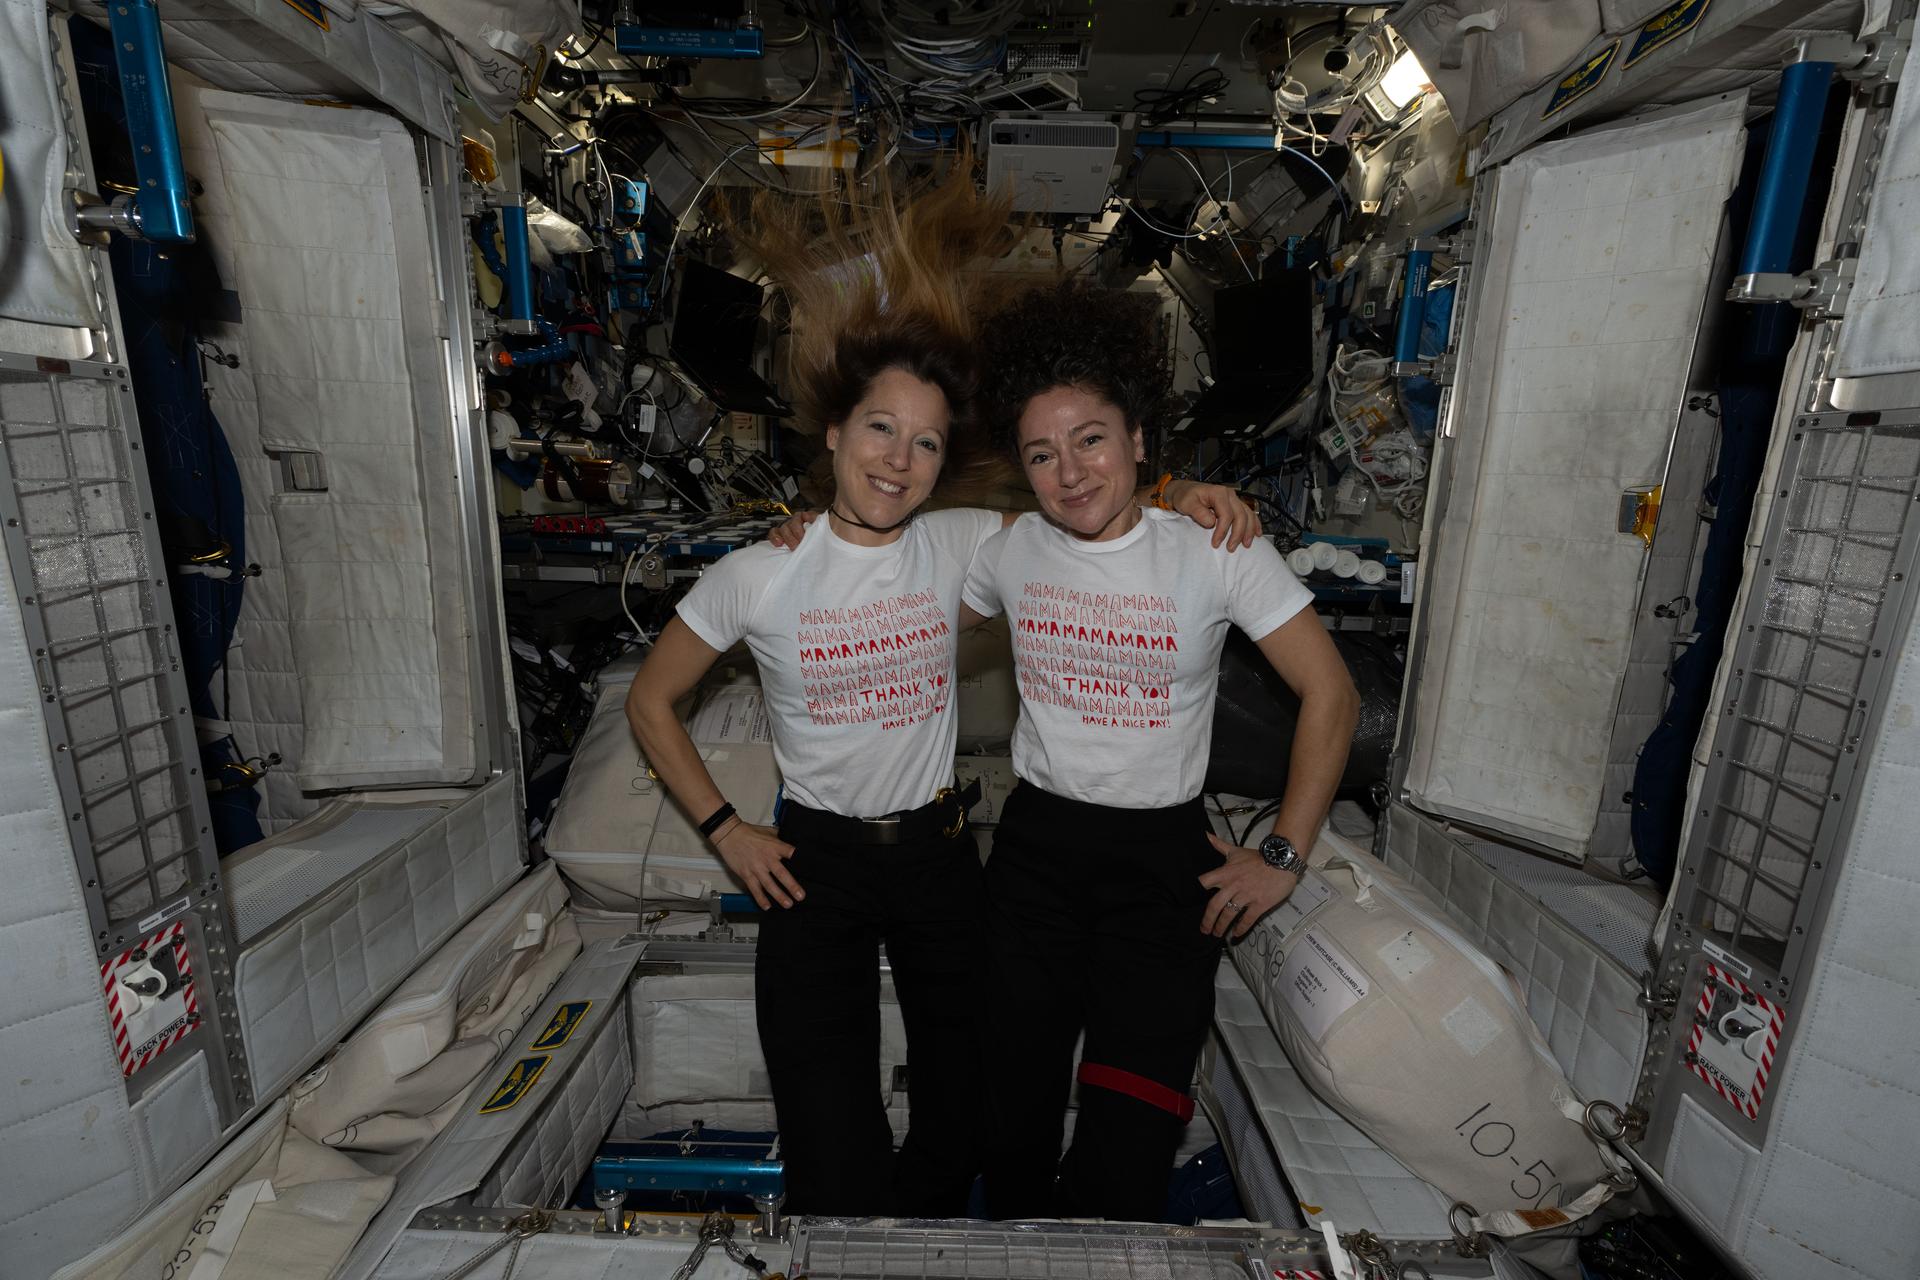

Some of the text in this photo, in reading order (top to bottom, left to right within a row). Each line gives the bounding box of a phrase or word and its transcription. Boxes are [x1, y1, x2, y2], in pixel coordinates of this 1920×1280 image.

[800, 621, 950, 663] MAMAMAMAMAMA
[1018, 618, 1178, 652] MAMAMAMAMAMA
[807, 671, 949, 713] MAMA THANK YOU
[959, 671, 983, 689] 34
[1063, 677, 1130, 699] THANK
[1139, 686, 1170, 700] YOU
[882, 718, 906, 731] HAVE
[909, 715, 915, 726] A
[1082, 714, 1171, 729] HAVE A NICE DAY!
[1315, 943, 1334, 963] SUITCASE
[136, 1017, 186, 1058] RACK POWER
[1699, 1057, 1746, 1100] RACK POWER
